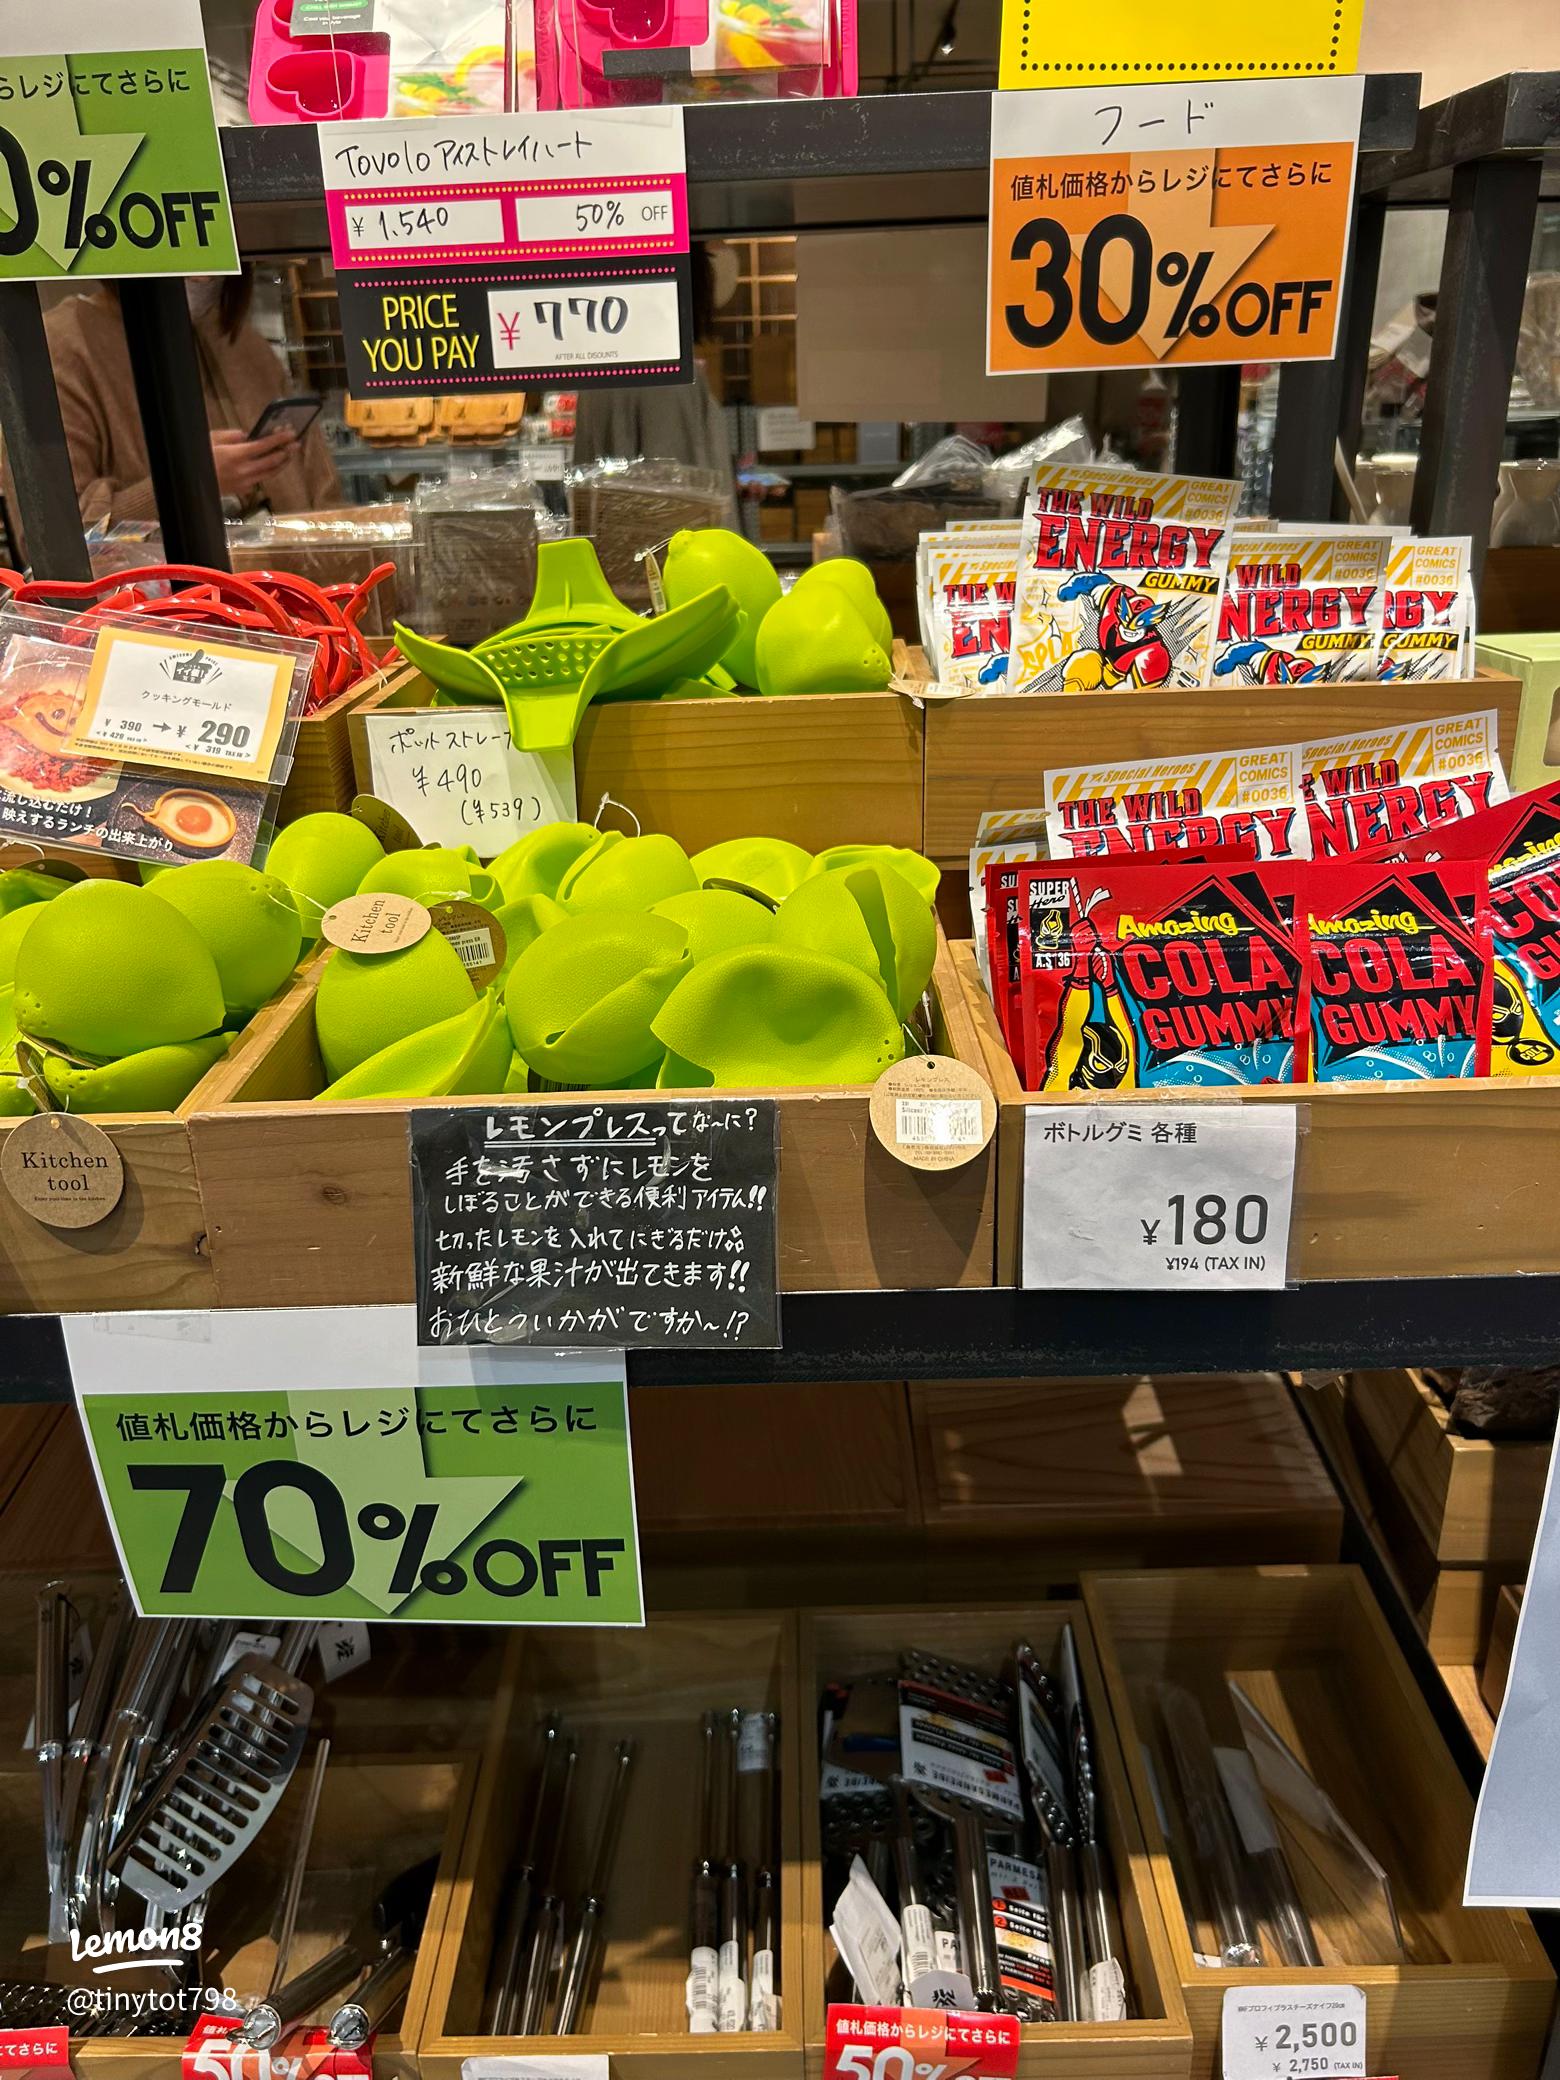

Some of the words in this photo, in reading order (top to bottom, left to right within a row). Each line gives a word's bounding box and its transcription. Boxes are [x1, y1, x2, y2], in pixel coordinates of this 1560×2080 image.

[1094, 99, 1214, 146] フード
[335, 140, 432, 178] Tovolo
[1010, 160, 1333, 201] 値札価格からレジにてさらに
[119, 191, 221, 249] OFF
[575, 200, 625, 232] 50%
[641, 205, 668, 222] OFF
[1005, 214, 1221, 349] 30%
[1225, 279, 1333, 337] OFF
[381, 293, 461, 331] PRICE
[497, 312, 521, 351] ¥
[533, 296, 629, 341] 770
[361, 337, 424, 373] YOU
[430, 333, 480, 371] PAY
[1187, 492, 1229, 505] COMICS
[1191, 481, 1231, 493] GREAT
[1037, 486, 1085, 515] THE
[1090, 492, 1154, 522] WILD
[1032, 513, 1225, 573] ENERGY
[1336, 540, 1378, 551] GREAT
[1415, 546, 1457, 557] GREAT
[1335, 551, 1378, 564] COMICS
[1415, 557, 1456, 569] COMICS
[1144, 572, 1218, 595] GUMMY
[1236, 563, 1301, 588] WILD
[1302, 633, 1374, 650] GUMMY
[141, 690, 233, 712] クッキングモールド
[120, 720, 142, 732] 390
[197, 720, 251, 748] 290
[1435, 717, 1481, 736] GREAT
[1435, 732, 1484, 751] COMICS
[1239, 752, 1288, 767] GREAT
[1438, 752, 1483, 770] #0036
[412, 763, 483, 798] ¥490
[1103, 767, 1150, 782] Special
[1239, 767, 1288, 782] COMICS
[1320, 759, 1399, 798] WILD
[1242, 786, 1287, 803] #0036
[1058, 796, 1118, 829] THE
[1125, 788, 1203, 823] WILD
[2, 807, 174, 852] 映えするランチの出来上がり
[1029, 881, 1070, 896] SUPER
[1029, 894, 1066, 909] Hero
[350, 899, 386, 944] Kitchen
[380, 912, 401, 935] tool
[1118, 910, 1243, 940] Amazing
[1124, 936, 1294, 1000] COLA
[1310, 934, 1476, 996] COLA
[1142, 995, 1295, 1050] GUMMY
[1322, 995, 1476, 1045] GUMMY
[1520, 1044, 1547, 1061] COLA
[1044, 1121, 1143, 1143] ボトルグミ
[1151, 1121, 1198, 1144] 各種
[20, 1152, 109, 1169] Kitchen
[47, 1174, 90, 1191] tool
[1140, 1194, 1269, 1246] ¥180
[1165, 1256, 1199, 1271] ¥194
[1204, 1256, 1239, 1272] (TAX
[1243, 1256, 1266, 1272] IN)
[115, 1403, 599, 1444] 値札価格からレジにてさらに
[126, 1459, 468, 1597] 70%
[472, 1538, 625, 1597] OFF
[836, 2019, 1011, 2045] 値札価格からレジにてさらに
[1255, 2036, 1268, 2051] ¥
[1275, 2021, 1357, 2053] 2,500
[1289, 2057, 1328, 2073] 2,750
